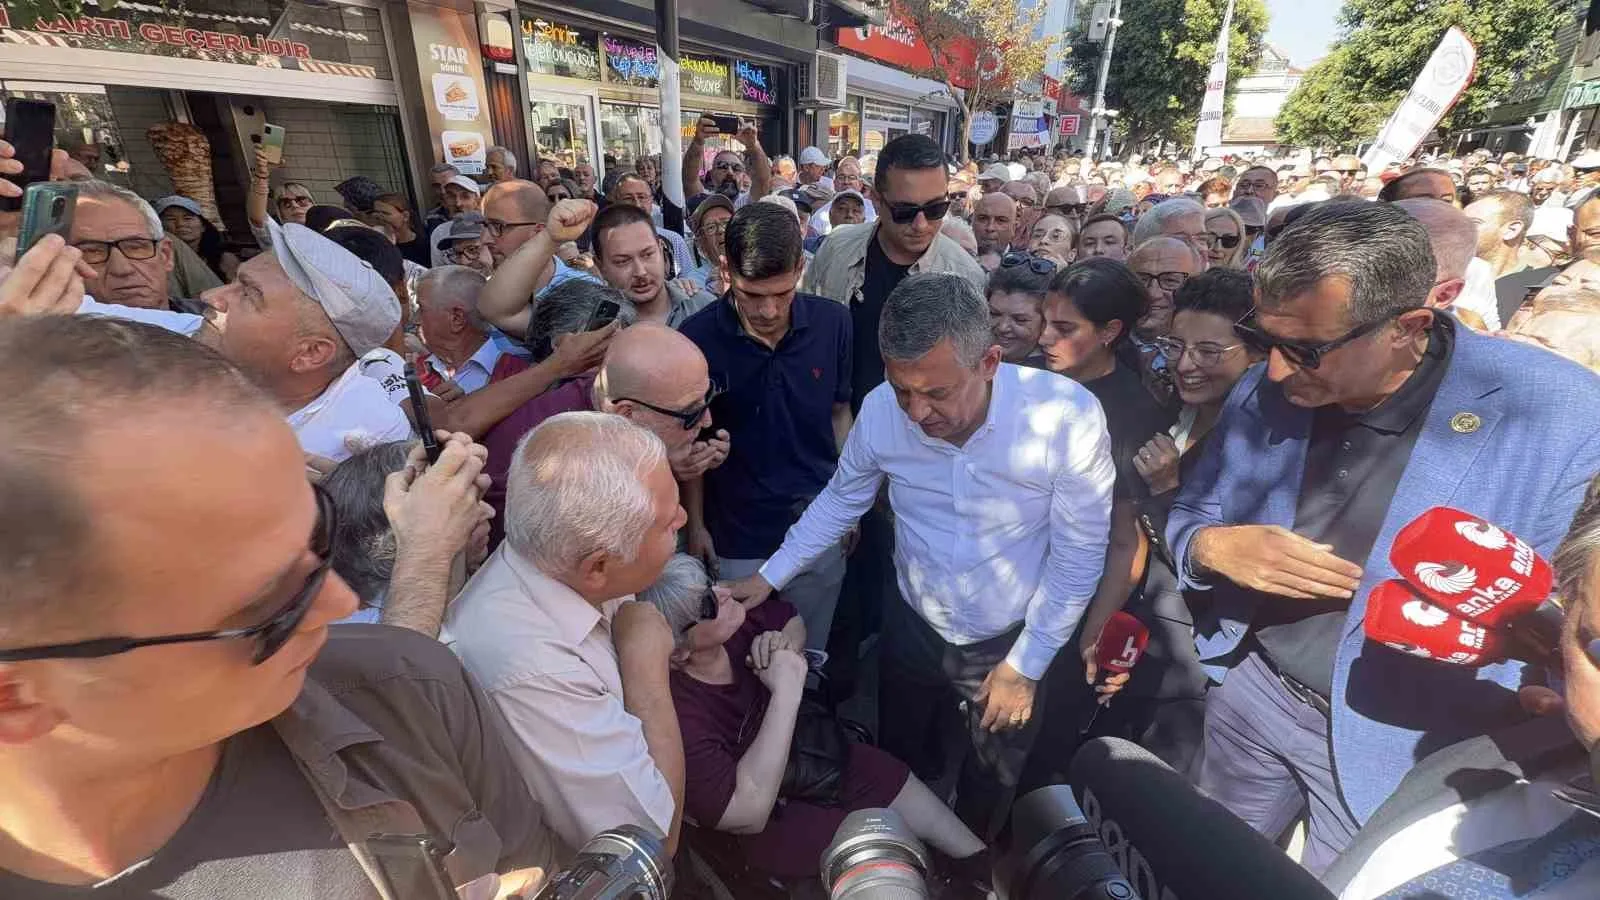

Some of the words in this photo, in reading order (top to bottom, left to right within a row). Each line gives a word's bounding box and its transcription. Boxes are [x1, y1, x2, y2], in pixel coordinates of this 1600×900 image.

[139, 23, 310, 59] GEÇERLİDİR
[430, 43, 469, 65] STAR
[1456, 577, 1517, 615] anka
